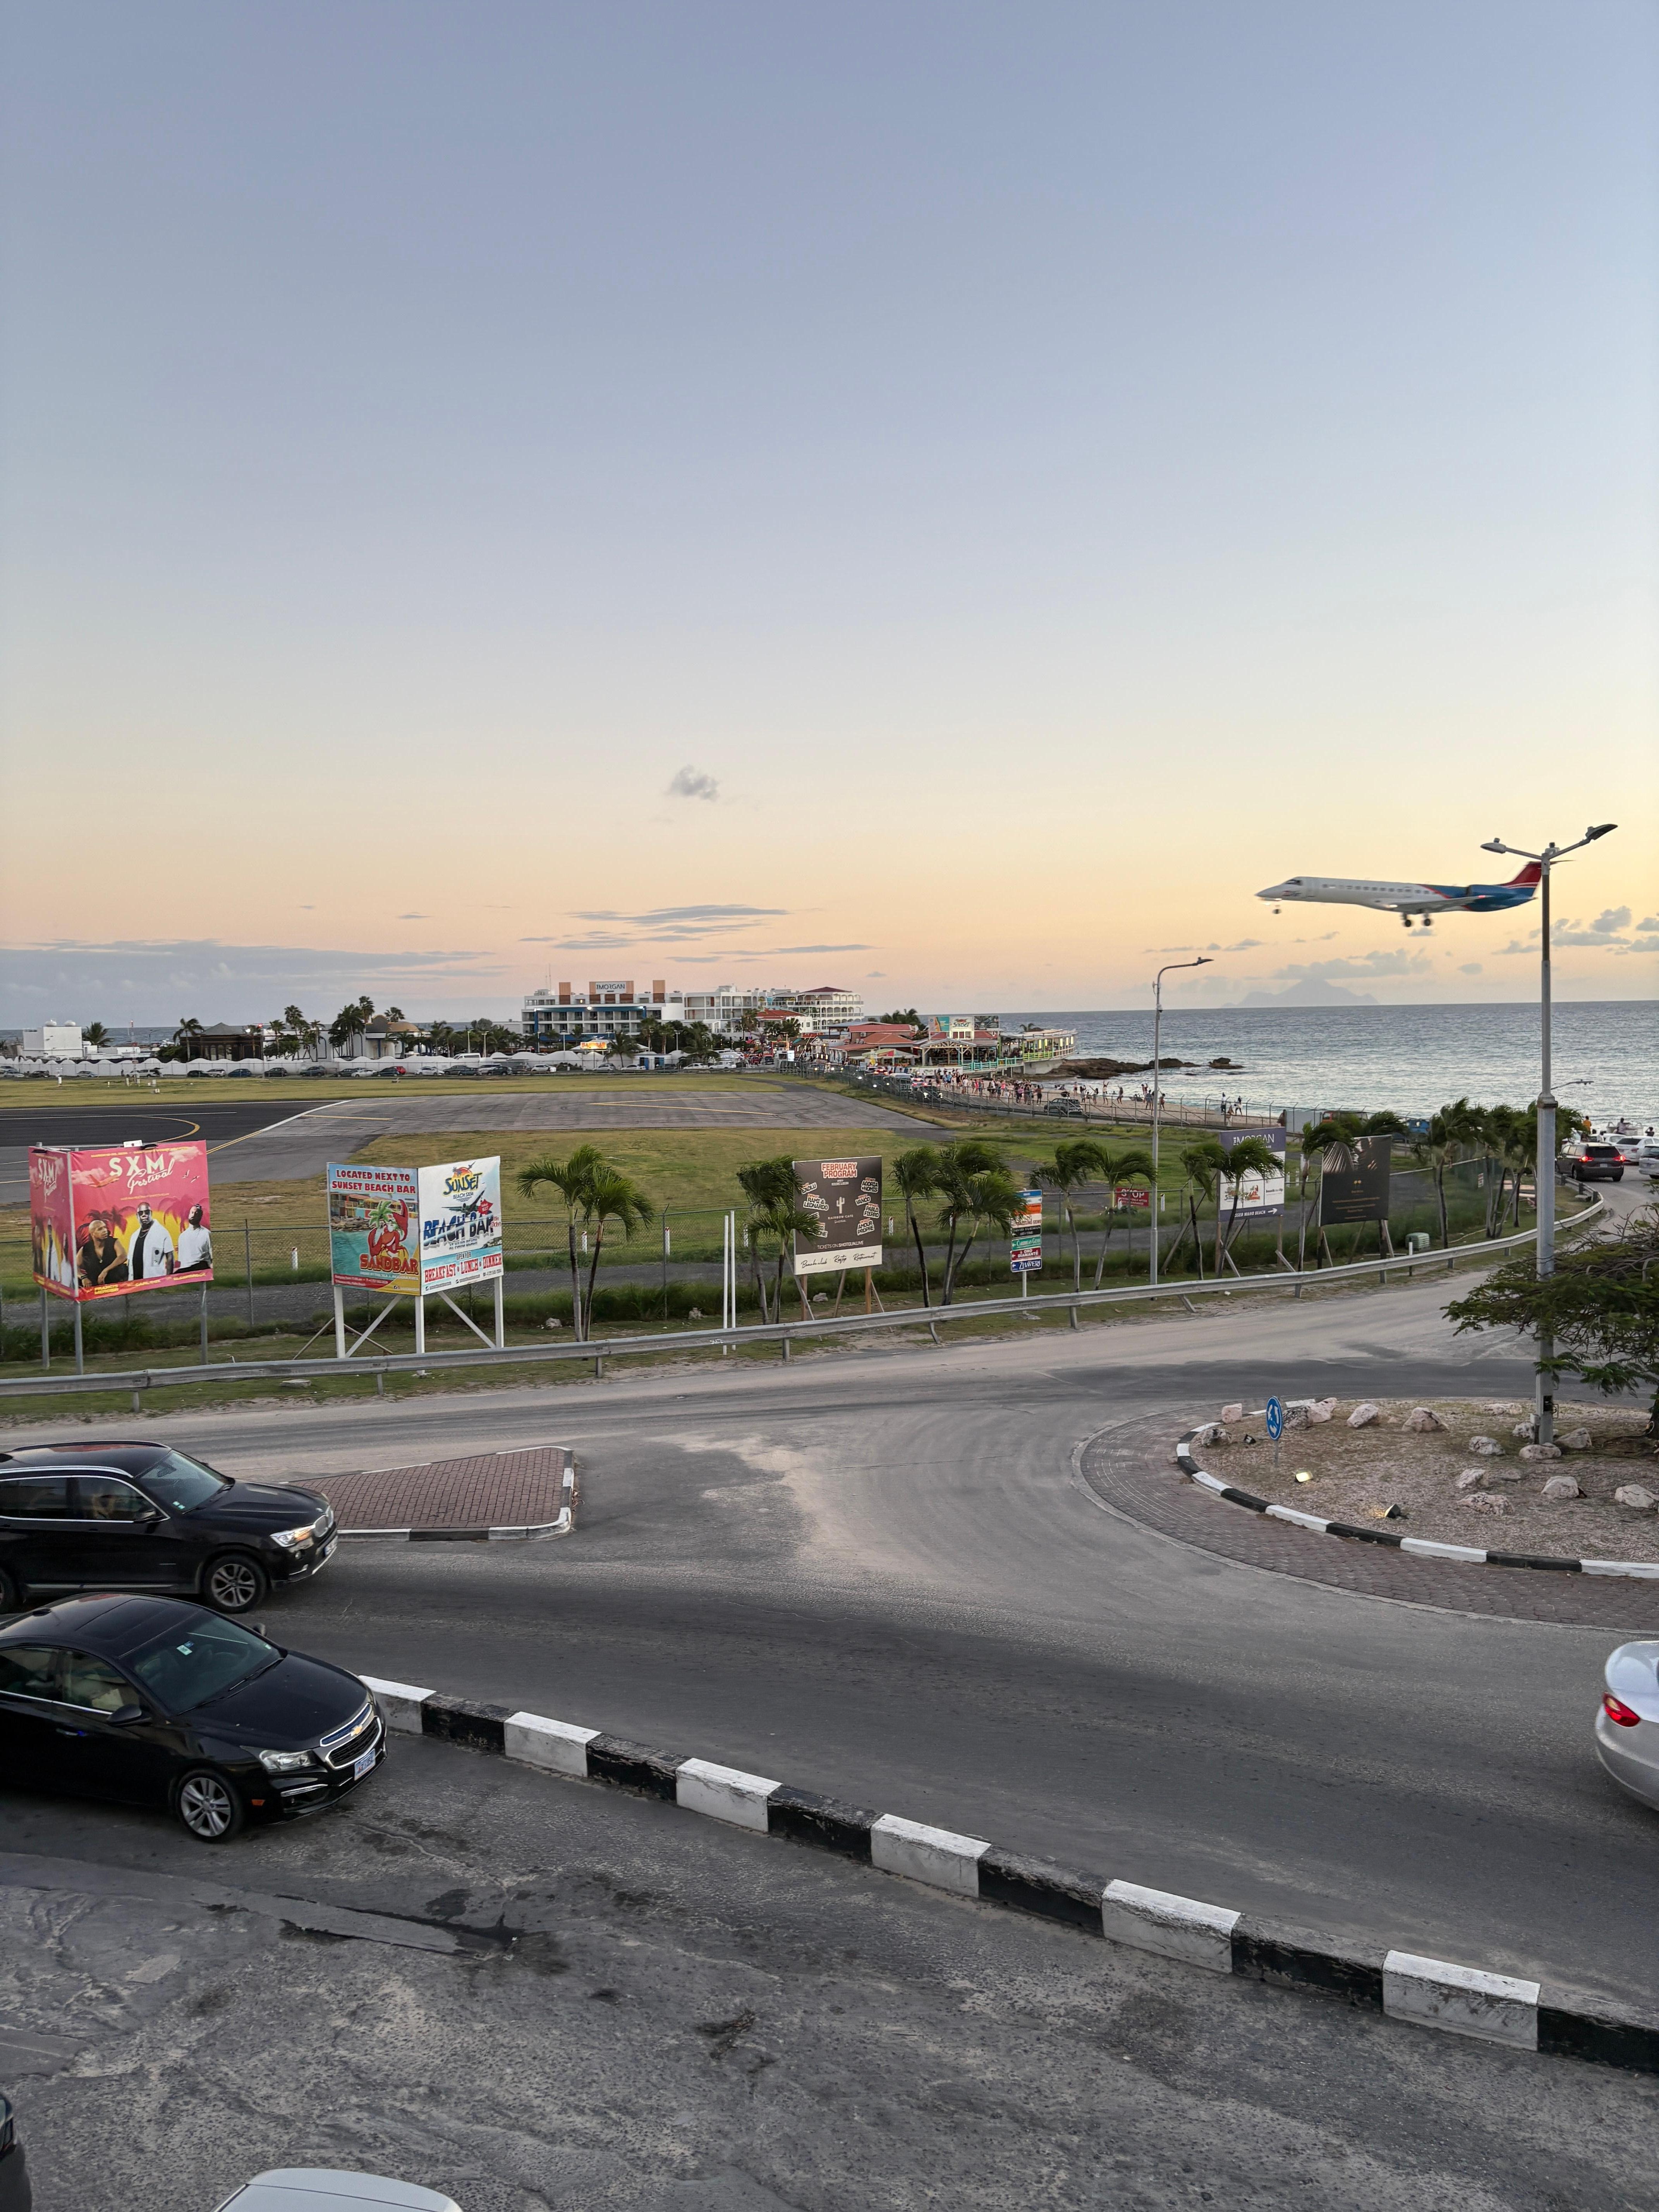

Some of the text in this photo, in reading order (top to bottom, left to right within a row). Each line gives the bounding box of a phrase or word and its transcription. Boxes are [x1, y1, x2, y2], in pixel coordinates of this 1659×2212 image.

[109, 1154, 164, 1176] SXM
[337, 1170, 372, 1179] LOCATED
[375, 1172, 397, 1181] NEXT
[127, 1158, 175, 1195] Festival
[332, 1181, 416, 1194] SUNSET BEACH BAR
[443, 1173, 483, 1195] SUNSET
[1121, 1189, 1144, 1198] SOP
[423, 1213, 466, 1247] BEACH
[360, 1254, 419, 1274] SANDBAR
[424, 1263, 456, 1283] BREAKFAST
[460, 1258, 478, 1274] LUNCH
[483, 1253, 502, 1269] DINNER
